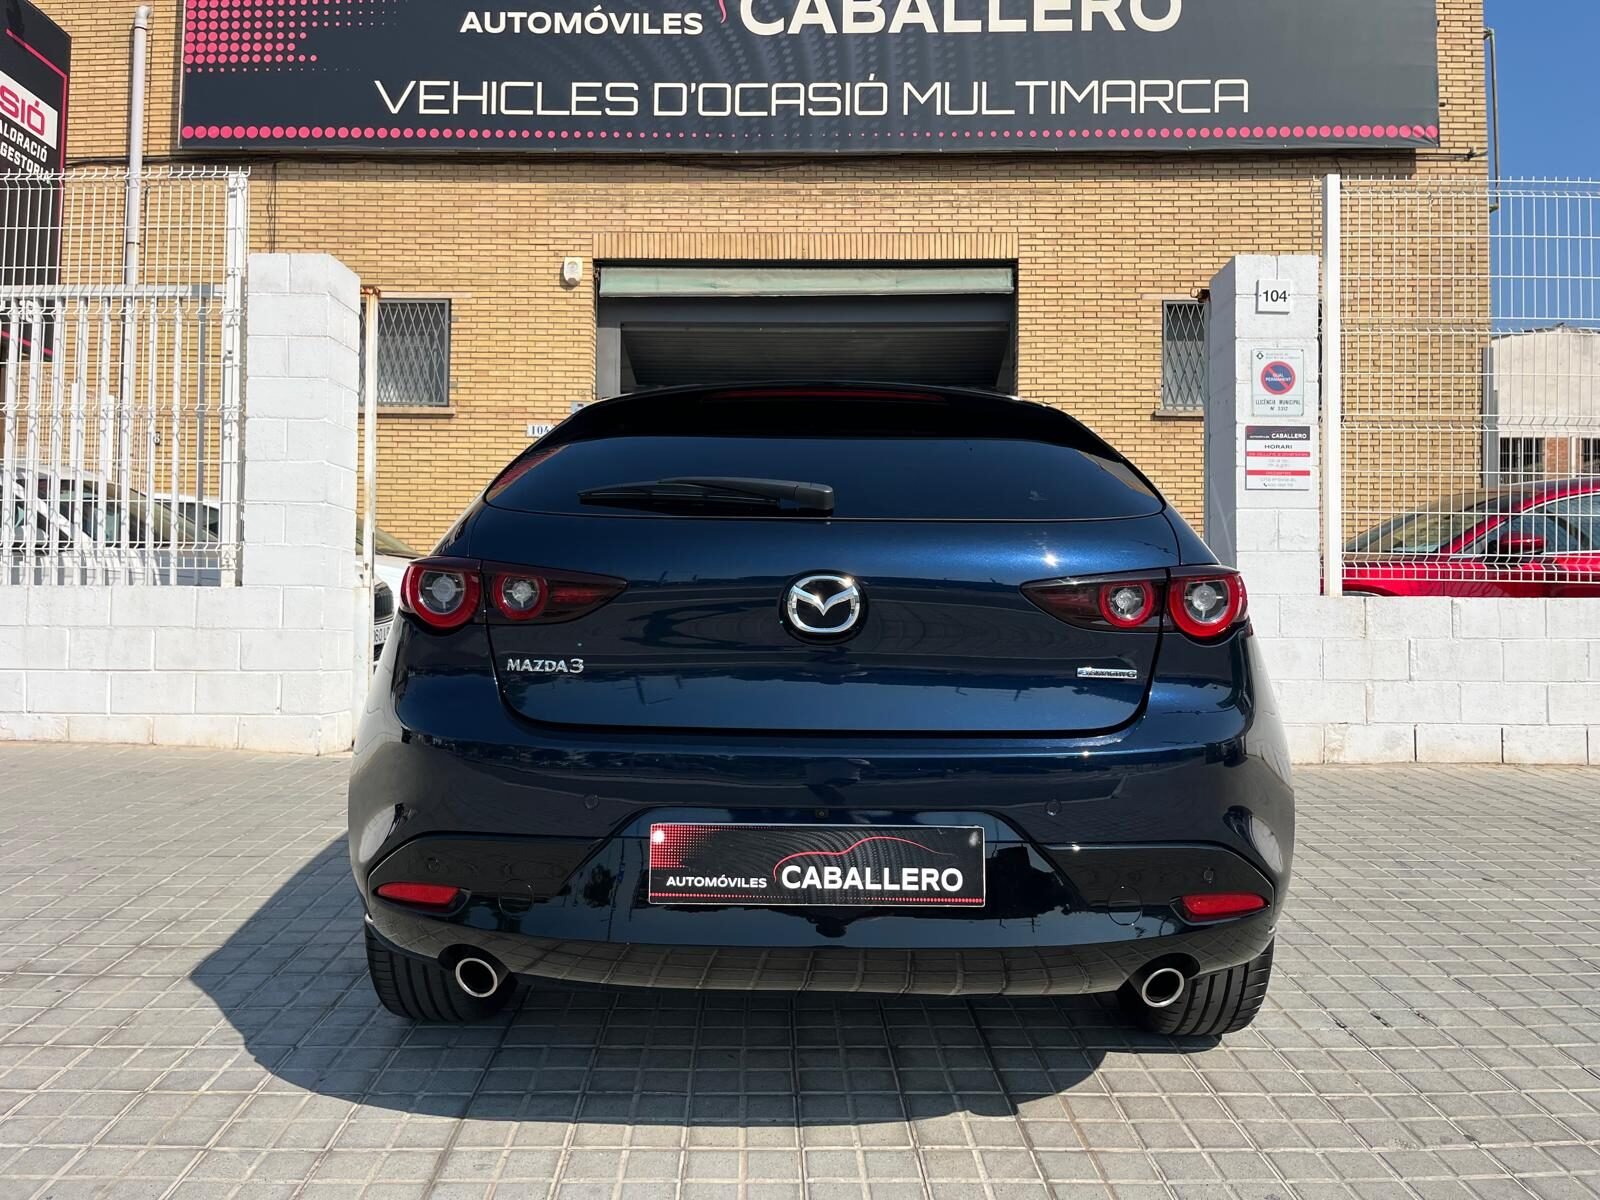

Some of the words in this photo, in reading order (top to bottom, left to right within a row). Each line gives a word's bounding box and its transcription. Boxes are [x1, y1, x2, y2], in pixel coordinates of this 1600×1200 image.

[460, 5, 704, 36] AUTOMÓVILES
[739, 0, 1184, 36] CABALLERO
[374, 79, 639, 117] VEHICLES
[653, 72, 889, 118] D'OCASIÓ
[903, 78, 1250, 117] MULTIMARCA
[1261, 289, 1288, 303] 104
[665, 874, 768, 889] AUTOMÓVILES
[781, 864, 963, 892] CABALLERO
